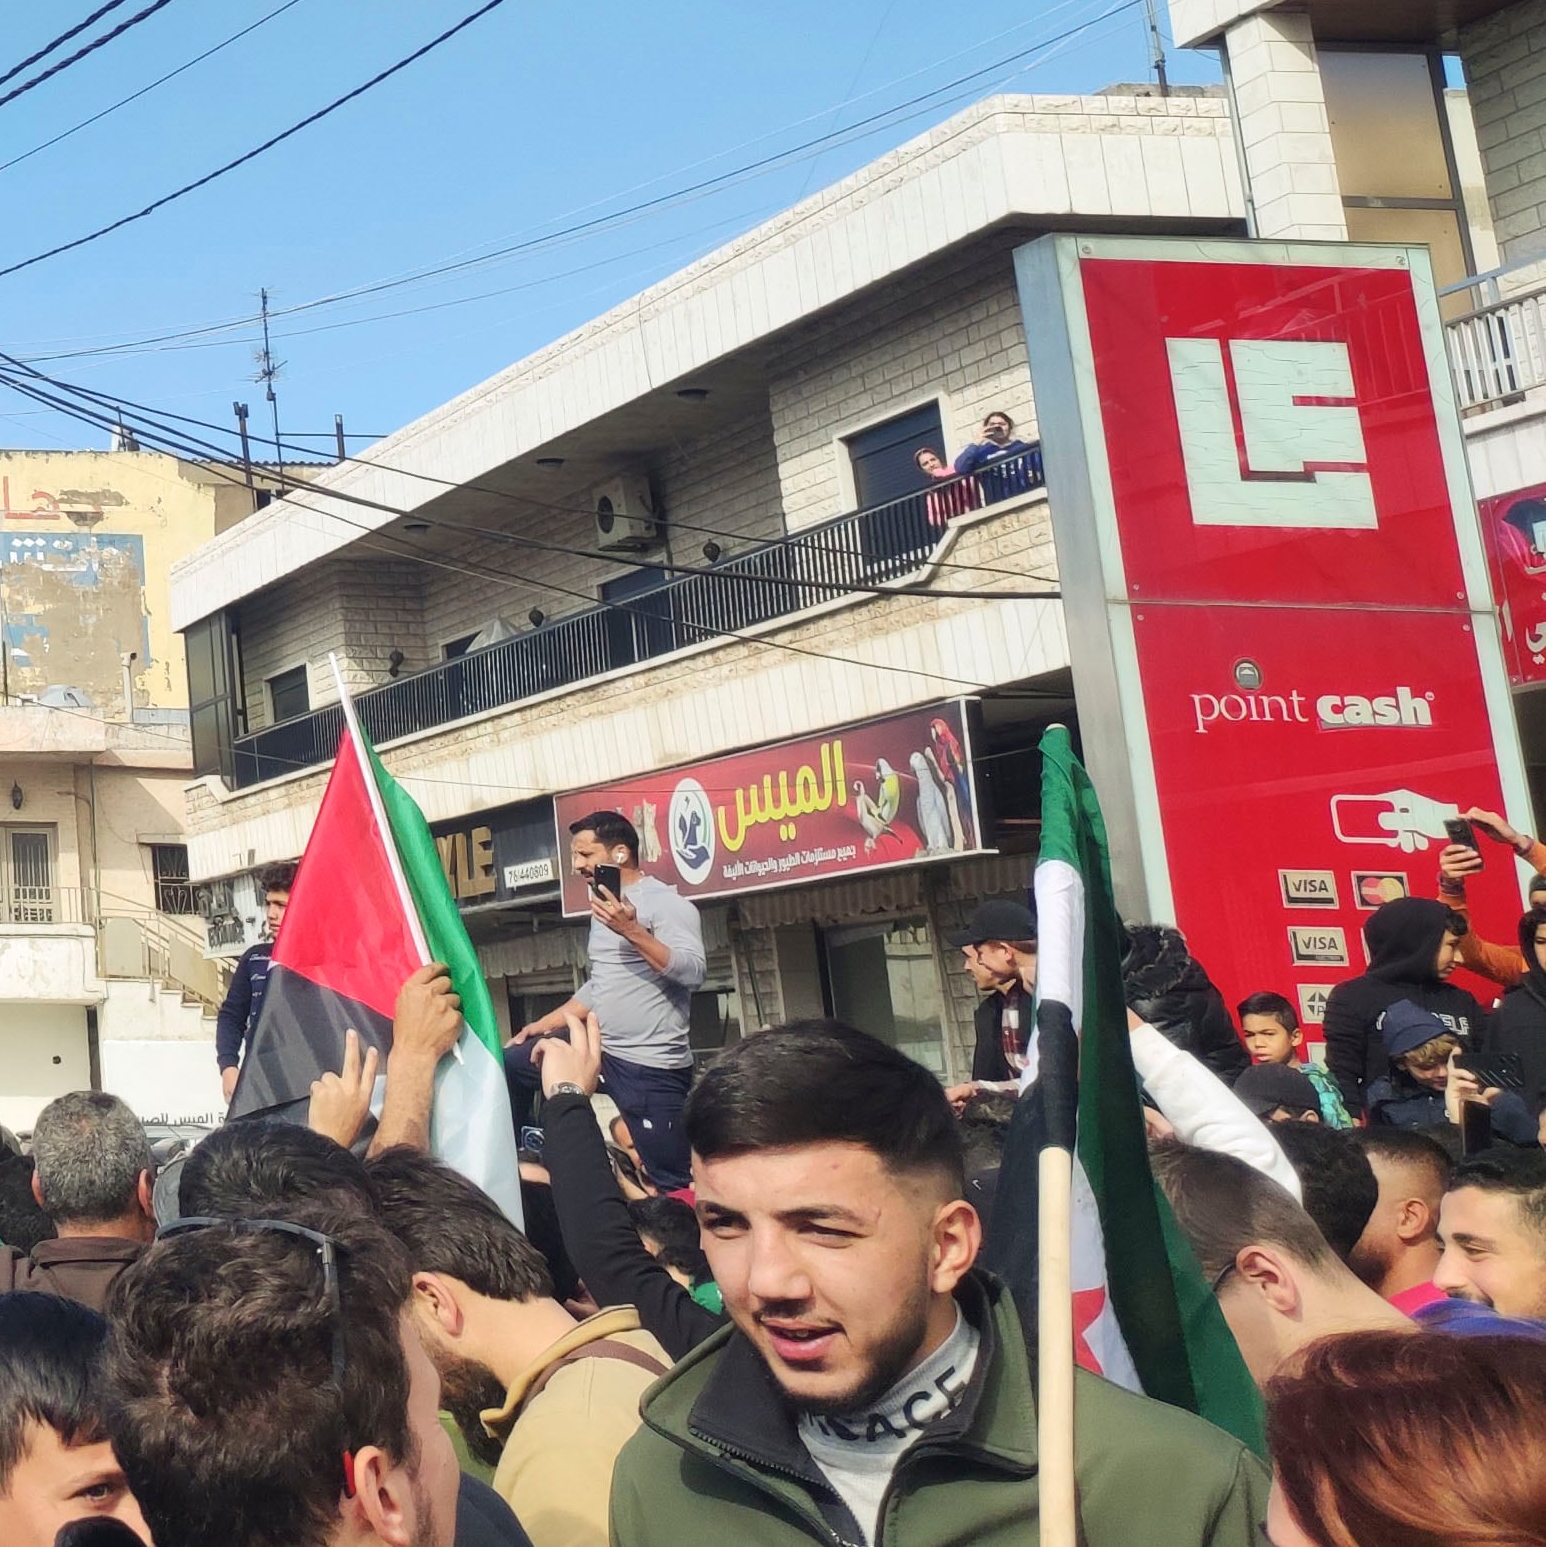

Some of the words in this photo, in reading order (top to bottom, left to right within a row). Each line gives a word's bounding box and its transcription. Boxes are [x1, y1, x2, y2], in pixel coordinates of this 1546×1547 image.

[1190, 690, 1309, 734] point
[1316, 686, 1433, 730] cash
[717, 740, 848, 852] الميس
[435, 826, 497, 899] YLE
[1292, 879, 1329, 893] VISA
[1302, 936, 1339, 951] VISA
